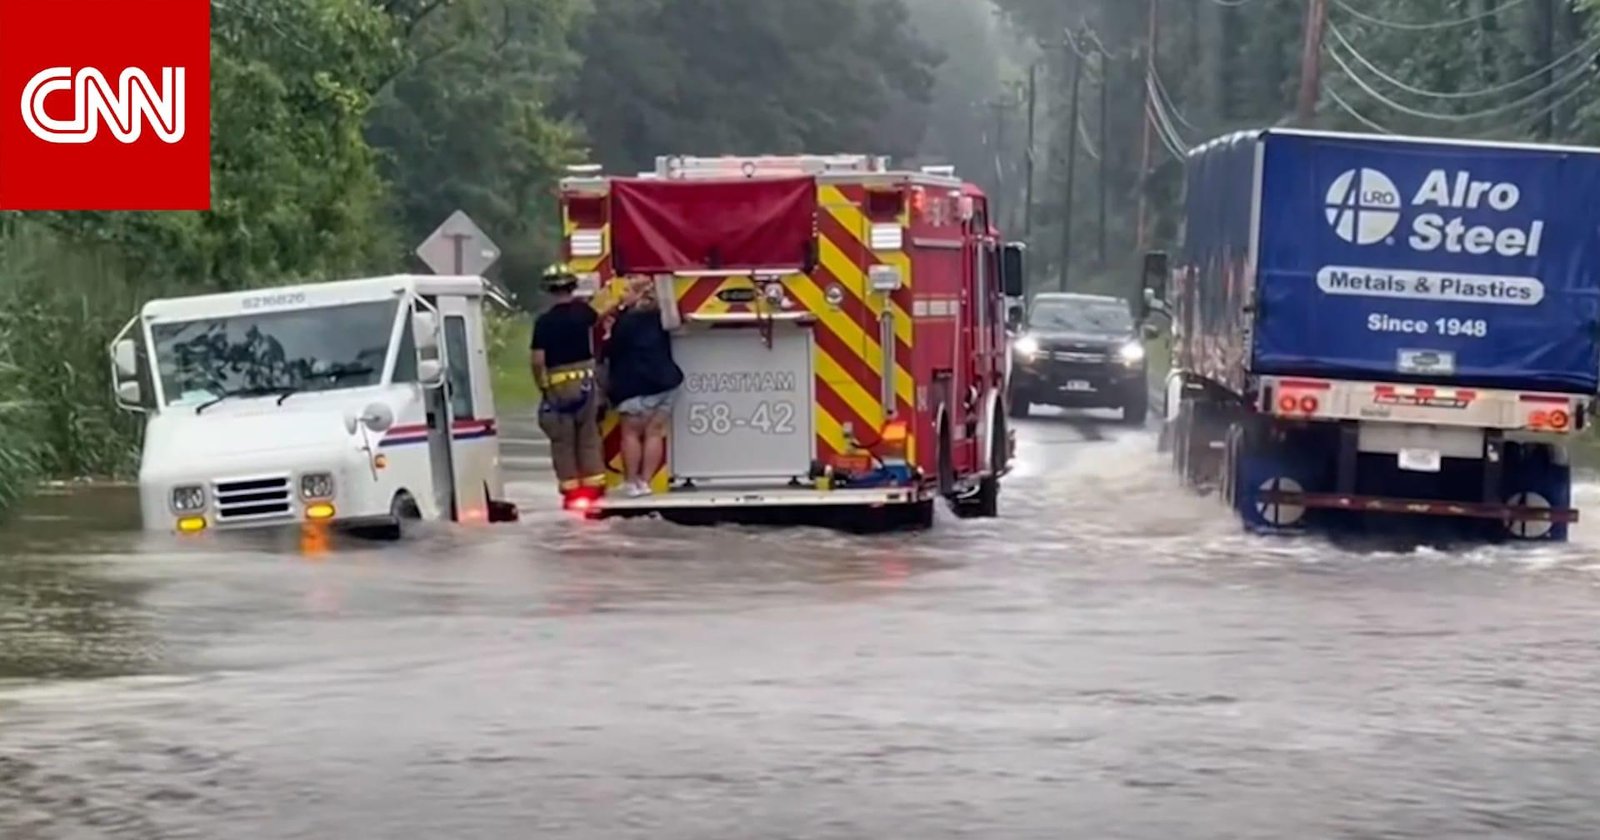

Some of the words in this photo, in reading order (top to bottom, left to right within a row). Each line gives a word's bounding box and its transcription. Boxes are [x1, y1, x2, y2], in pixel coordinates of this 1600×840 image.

[1411, 168, 1520, 211] Alro
[1408, 212, 1544, 257] Steel
[1329, 270, 1406, 293] Metals
[1413, 276, 1431, 294] &
[1440, 277, 1532, 300] Plastics
[1367, 313, 1429, 334] Since
[1435, 317, 1488, 338] 1948
[685, 371, 795, 393] CHATHAM
[687, 401, 796, 435] 58-42
